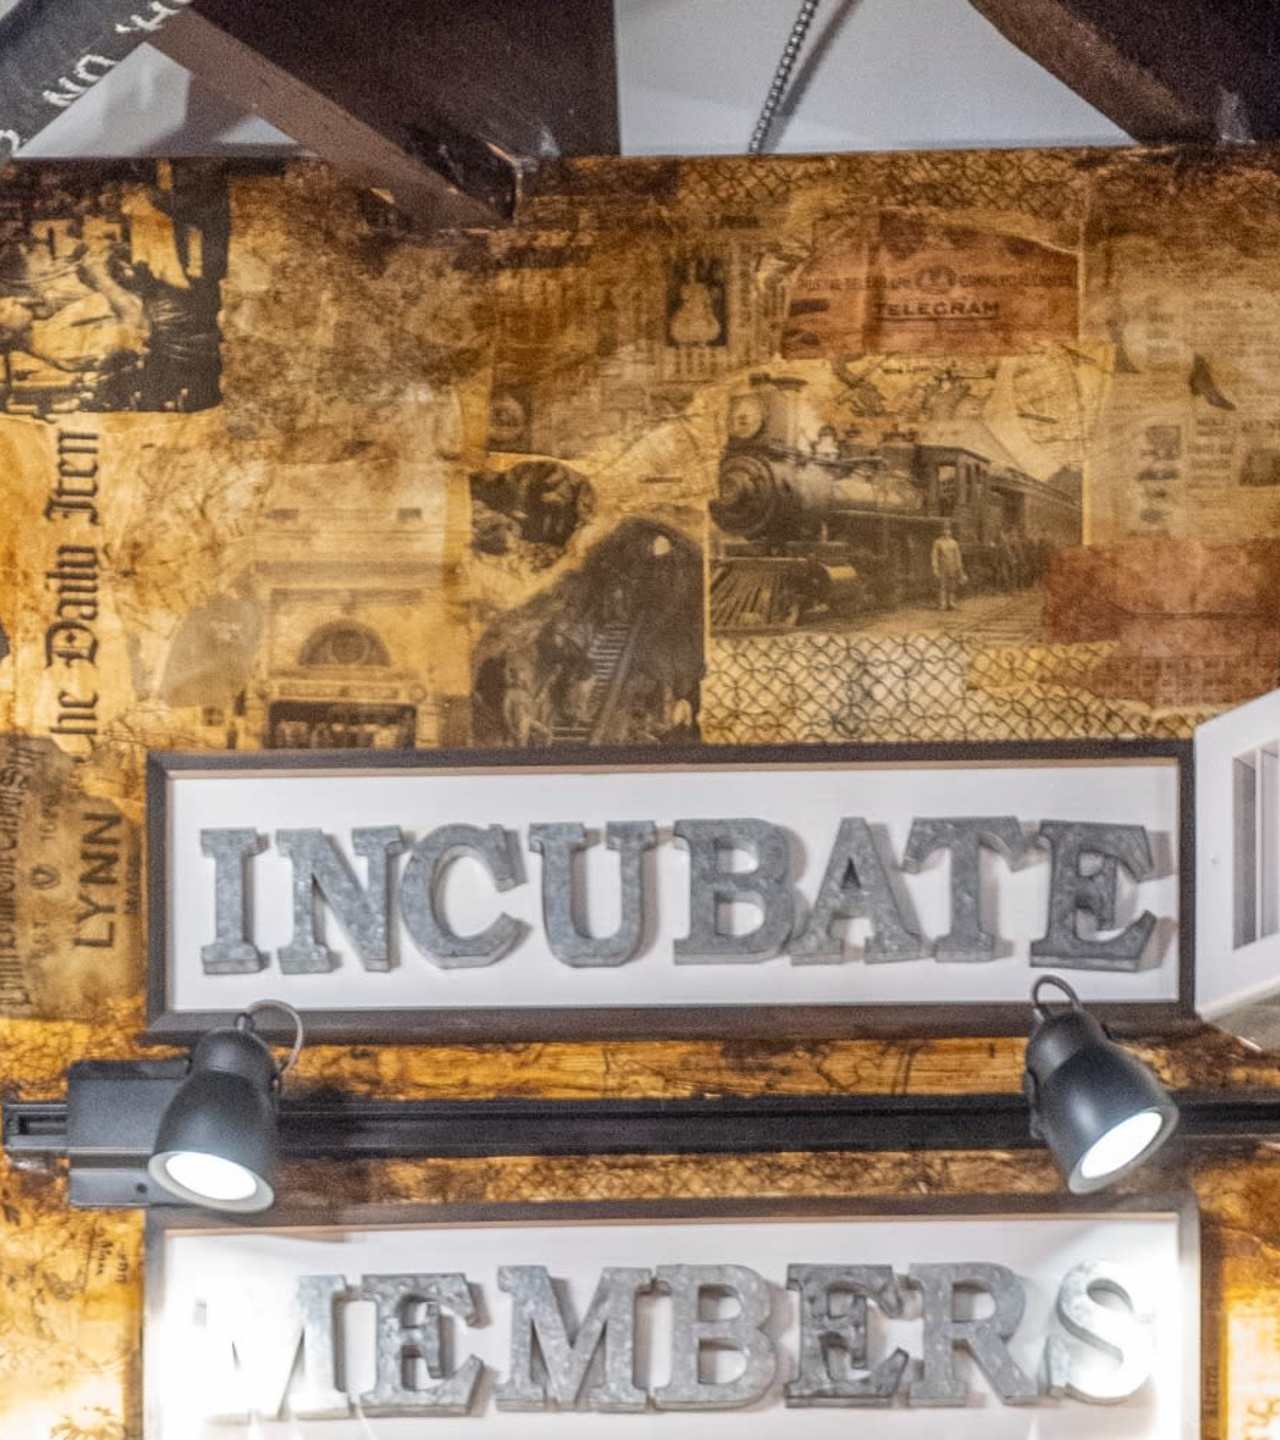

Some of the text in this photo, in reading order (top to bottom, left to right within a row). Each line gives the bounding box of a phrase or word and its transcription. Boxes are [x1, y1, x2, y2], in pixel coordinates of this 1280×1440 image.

[876, 302, 1000, 317] TELEGRAM
[45, 536, 102, 672] Daily
[54, 686, 101, 760] he
[73, 812, 121, 949] LYNN
[200, 816, 1160, 976] INCUBATE
